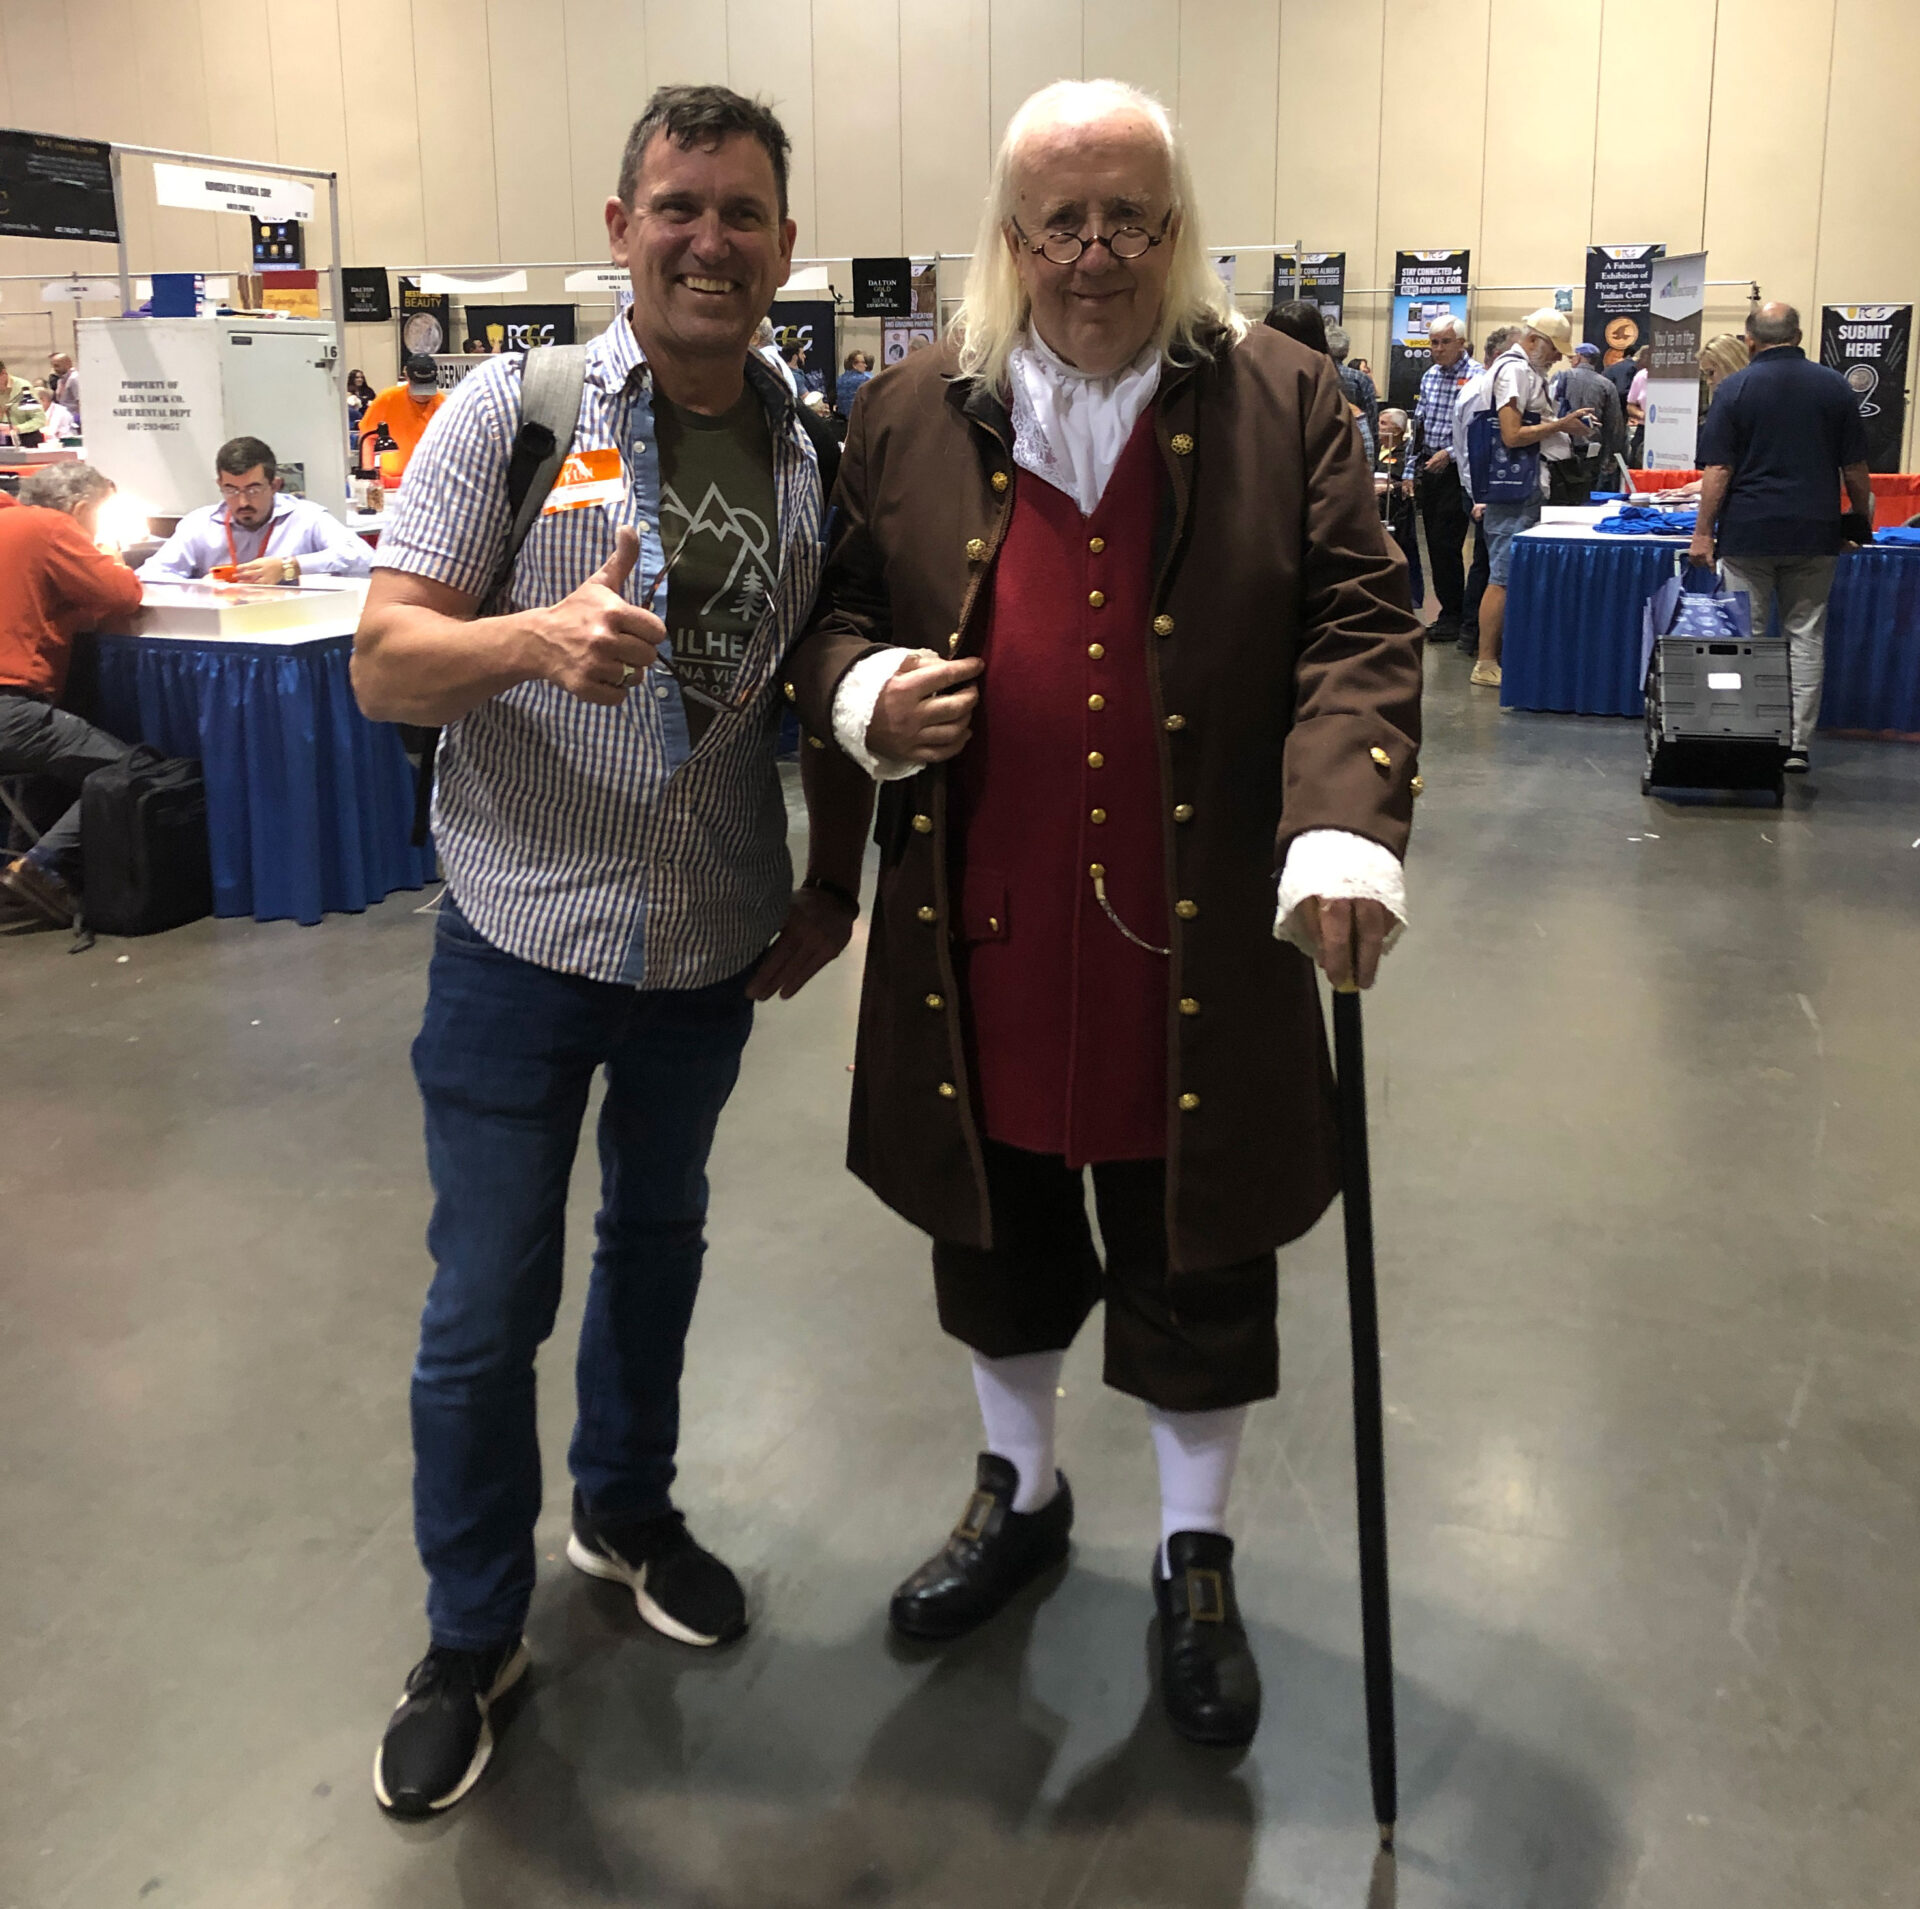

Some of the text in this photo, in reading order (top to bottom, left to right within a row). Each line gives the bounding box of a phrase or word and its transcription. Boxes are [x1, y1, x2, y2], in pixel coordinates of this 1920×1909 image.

[1402, 267, 1452, 276] STAY CONNECTED
[1401, 276, 1462, 285] FOLLOW US FOR
[1595, 282, 1618, 290] Flying
[1619, 281, 1639, 290] Eagle
[405, 298, 442, 308] BEAUTY
[507, 324, 555, 349] PCGS
[1838, 325, 1893, 340] SUBMIT
[1655, 331, 1695, 347] You're in the
[323, 345, 338, 358] 16
[1845, 342, 1882, 358] HERE
[1651, 350, 1666, 368] right
[1666, 349, 1685, 367] place
[121, 381, 178, 389] PROPERTY OF
[147, 395, 169, 403] LOCK
[112, 409, 191, 417] SAFE RENTAL DEPT
[676, 627, 744, 659] ILHE
